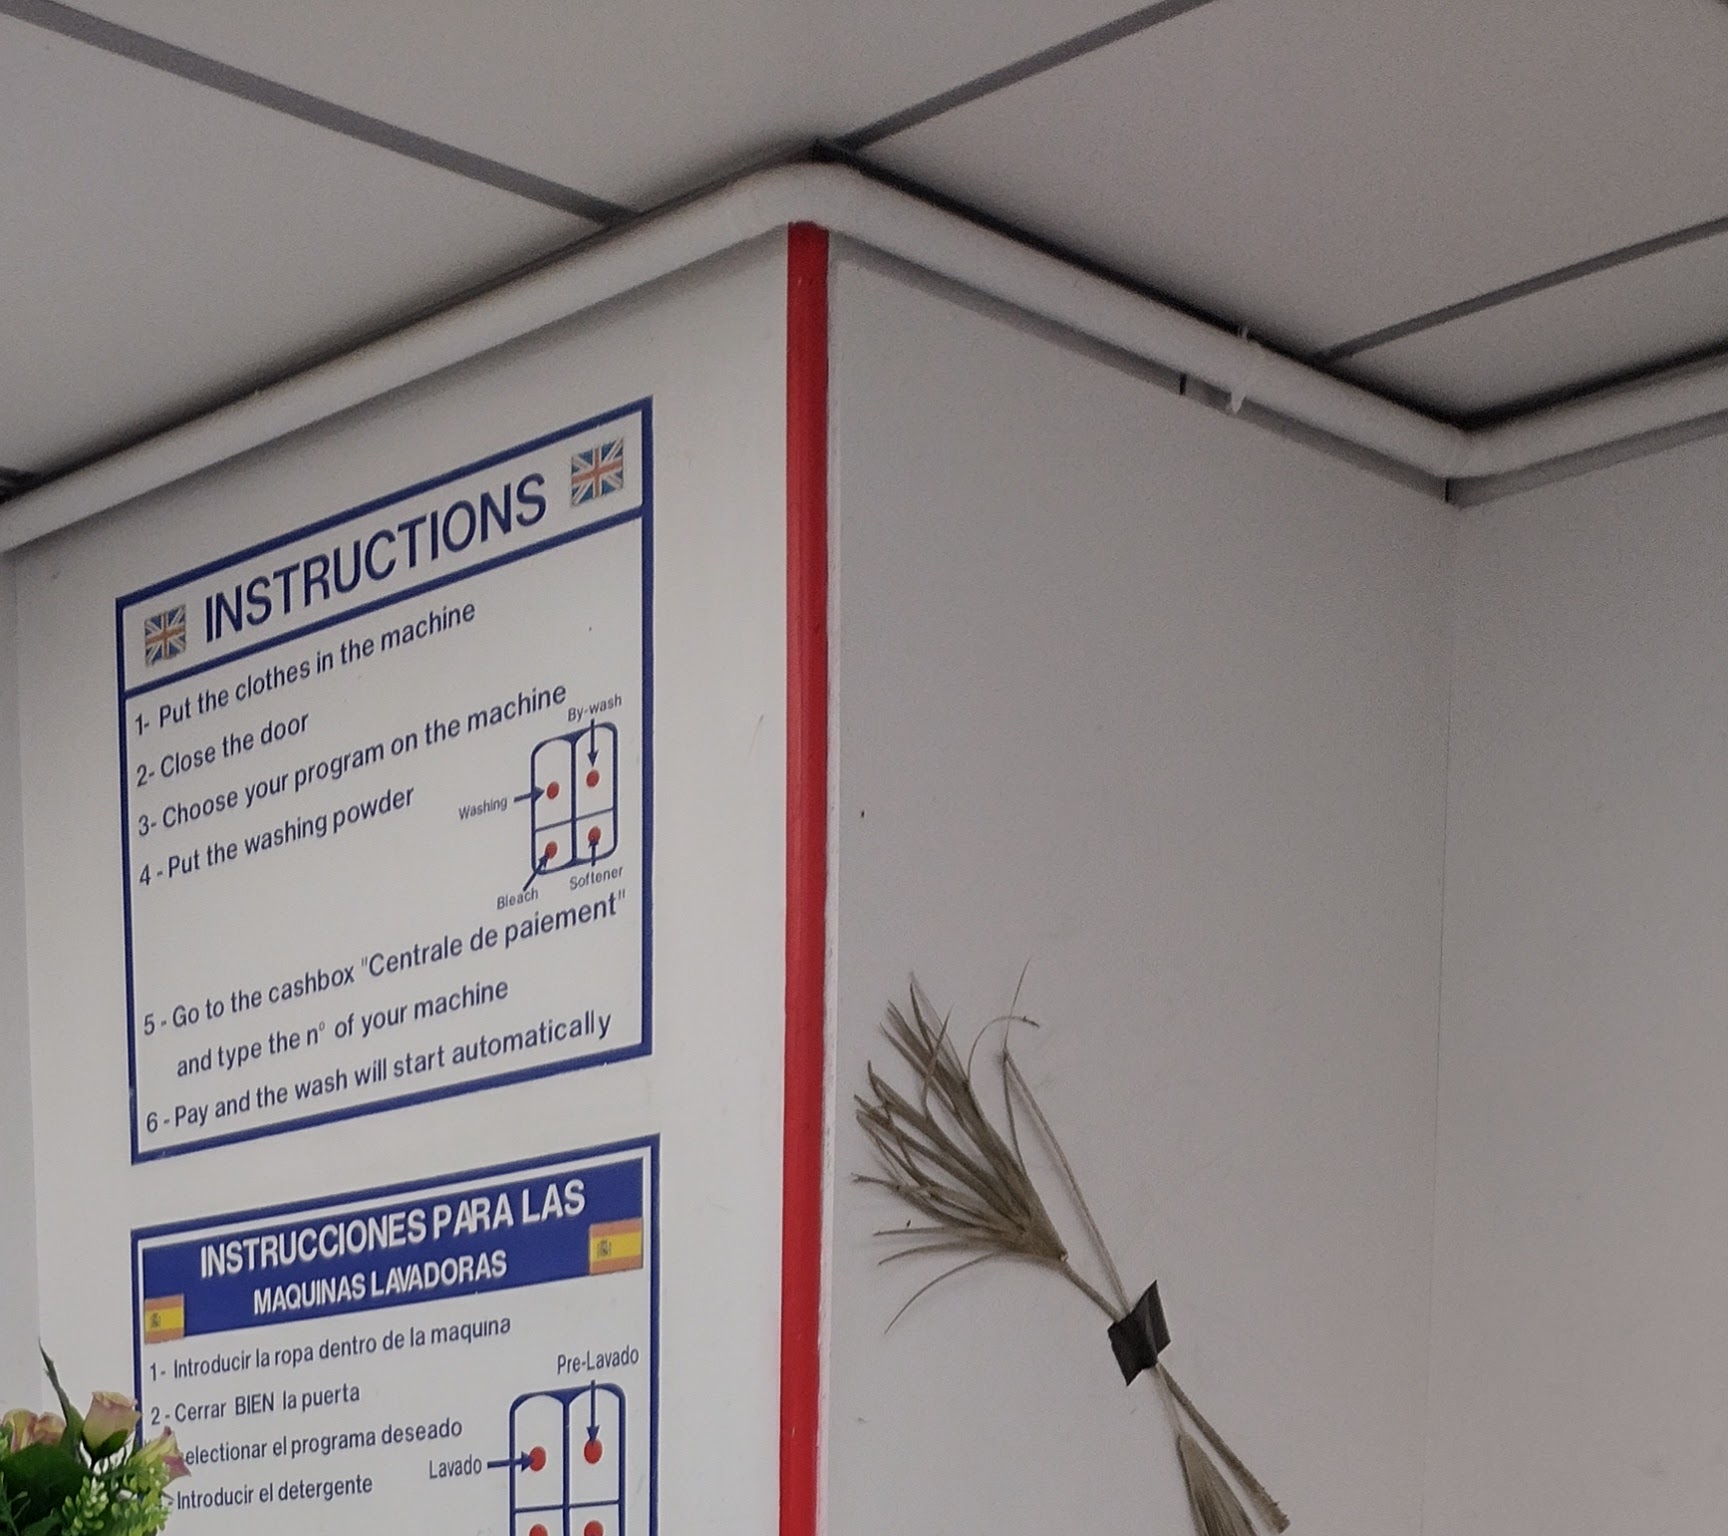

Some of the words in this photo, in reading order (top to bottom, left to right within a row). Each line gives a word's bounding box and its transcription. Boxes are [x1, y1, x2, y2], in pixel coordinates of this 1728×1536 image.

[205, 472, 549, 643] INSTRUCTIONS
[160, 696, 192, 729] Put
[197, 688, 229, 715] the
[235, 659, 310, 704] clothes
[317, 649, 334, 675] in
[340, 638, 374, 666] the
[381, 603, 475, 653] machine
[568, 693, 622, 724] By-wash
[160, 745, 216, 778] Close
[222, 732, 254, 758] the
[261, 713, 309, 747] door
[163, 790, 238, 830] Choose
[244, 773, 289, 809] your
[295, 743, 384, 794] program
[391, 732, 418, 756] on
[424, 719, 461, 747] the
[468, 685, 566, 734] machine
[168, 848, 201, 879] Put
[206, 842, 238, 868] the
[244, 814, 327, 856] washing
[333, 787, 414, 835] powder
[459, 797, 507, 820] Washing
[497, 888, 538, 910] Bleach
[569, 865, 623, 891] Softener
[172, 1005, 199, 1028] Go
[205, 998, 224, 1020] to
[230, 989, 262, 1014] the
[269, 965, 355, 1005] cashbox
[470, 926, 498, 952] de
[177, 1048, 212, 1077] and
[218, 1042, 262, 1071] type
[268, 1030, 301, 1056] the
[334, 1012, 354, 1039] of
[361, 1004, 408, 1038] your
[414, 981, 508, 1021] machine
[175, 1104, 209, 1129] Pay
[215, 1089, 250, 1119] and
[256, 1084, 288, 1111] the
[294, 1068, 348, 1101] wash
[354, 1057, 387, 1088] will
[393, 1045, 445, 1079] start
[452, 1009, 611, 1065] automatically
[201, 1208, 426, 1279] INSTRUCCIONES
[433, 1192, 514, 1241] PARA
[522, 1179, 585, 1225] LAS
[254, 1272, 366, 1316] MAQUINAS
[370, 1249, 507, 1298] LAVADORAS
[174, 1350, 251, 1379] Introducir
[256, 1348, 270, 1368] la
[275, 1346, 313, 1369] ropa
[319, 1335, 377, 1360] dentro
[382, 1329, 405, 1351] de
[410, 1326, 425, 1348] la
[557, 1344, 639, 1376] Pre-Lavado
[175, 1402, 227, 1423] Cerrar
[235, 1391, 274, 1416] BIEN
[283, 1390, 297, 1411] la
[301, 1383, 360, 1414] puerta
[273, 1435, 287, 1457] el
[291, 1431, 376, 1460] programa
[381, 1417, 462, 1446] deseado
[429, 1454, 482, 1480] Lavado
[177, 1484, 254, 1510] Introducir
[259, 1482, 273, 1503] el
[278, 1474, 373, 1503] detergente
